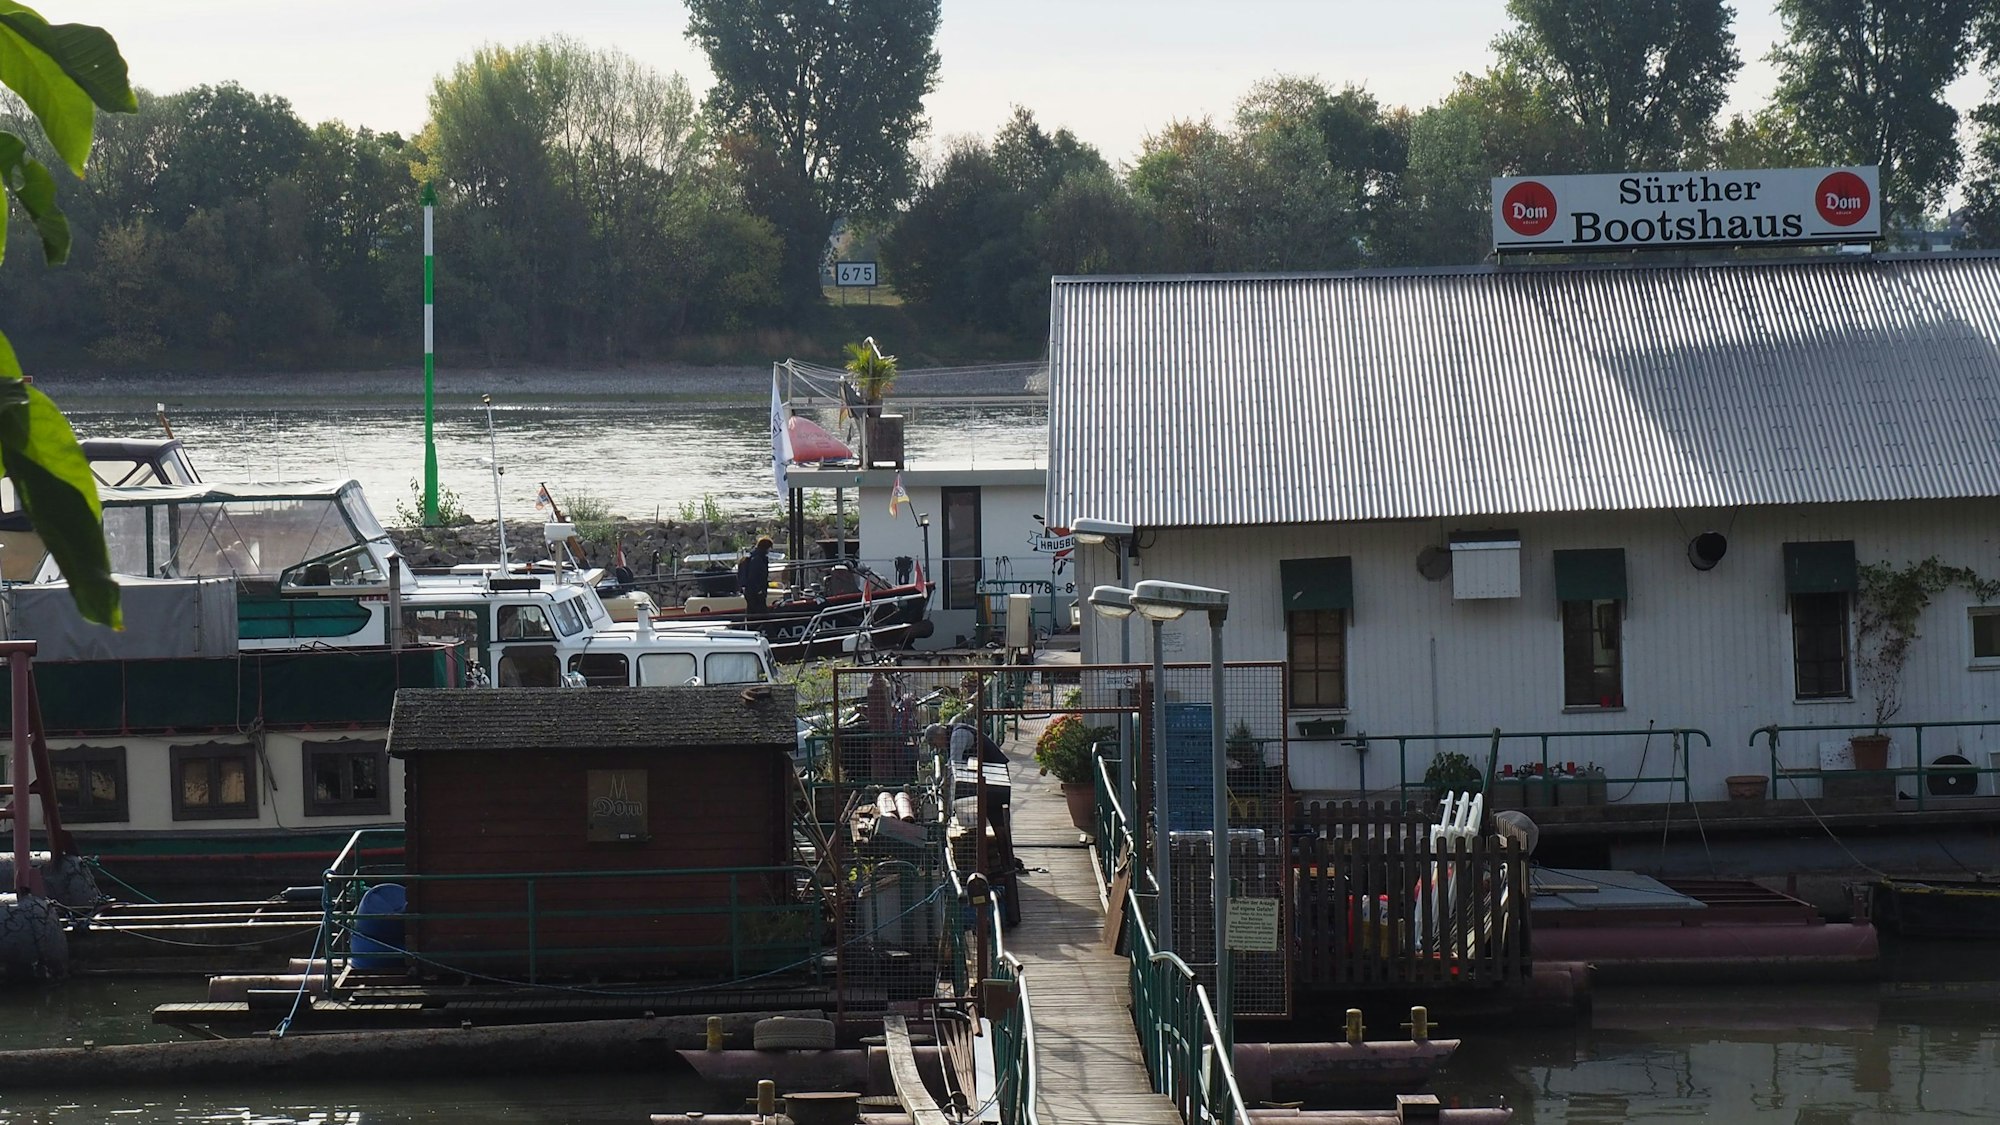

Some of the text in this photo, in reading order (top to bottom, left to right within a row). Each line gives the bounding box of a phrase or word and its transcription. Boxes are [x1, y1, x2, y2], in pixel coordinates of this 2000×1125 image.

[1619, 176, 1761, 205] Sürther
[1825, 192, 1861, 210] Dom
[1512, 202, 1548, 219] Dom
[1570, 208, 1803, 244] Bootshaus
[841, 267, 872, 281] 675
[1020, 582, 1052, 594] 0178
[593, 796, 643, 817] Dom
